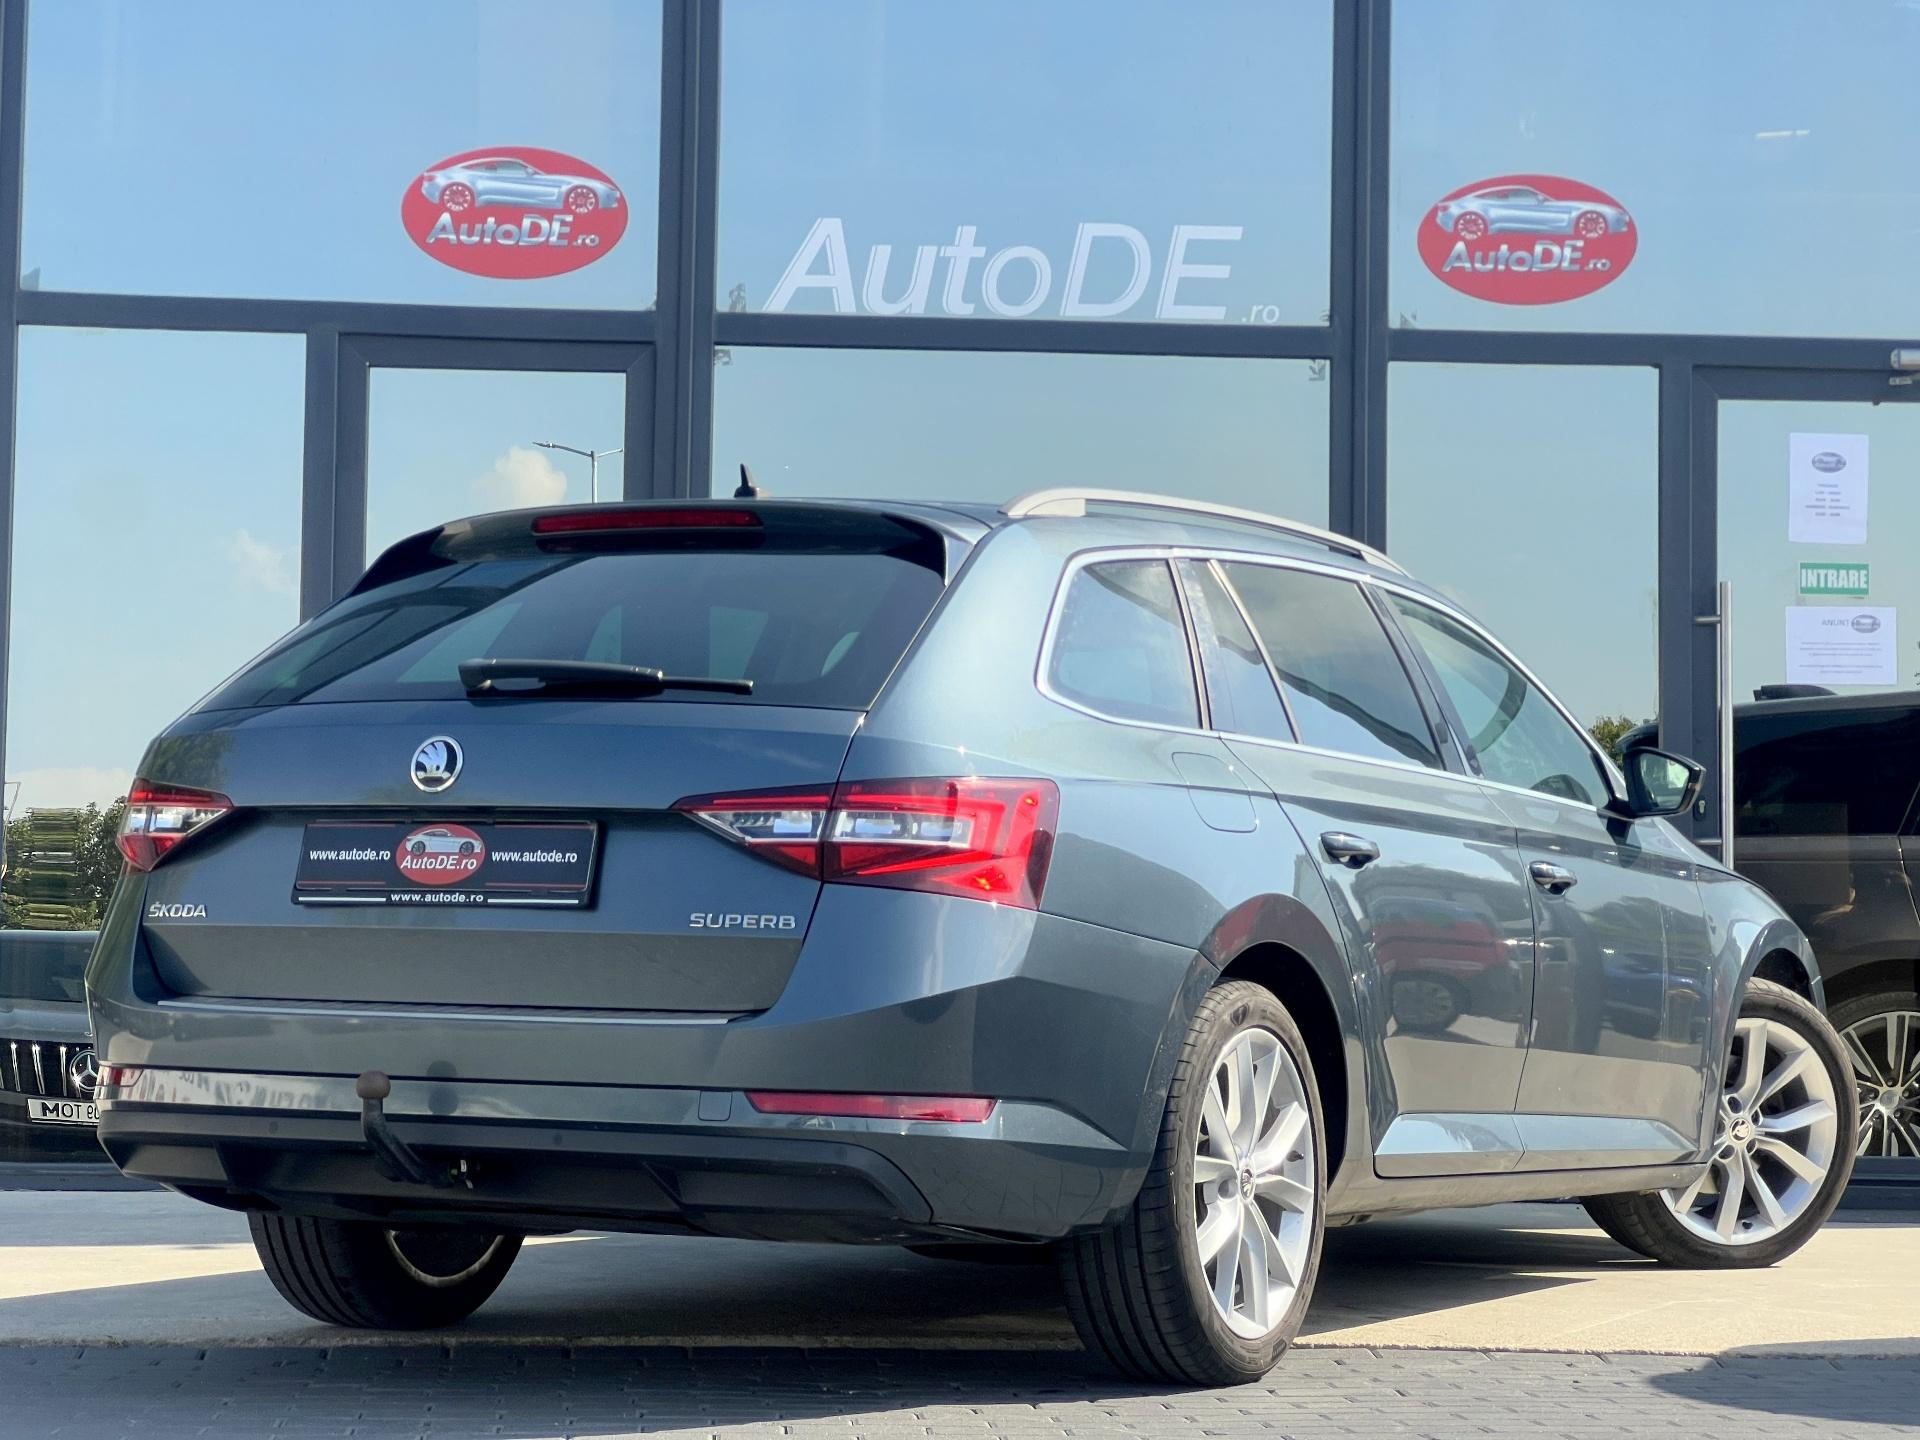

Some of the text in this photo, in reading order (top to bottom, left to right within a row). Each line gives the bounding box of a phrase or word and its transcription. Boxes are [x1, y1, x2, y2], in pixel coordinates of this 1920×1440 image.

[1800, 568, 1869, 590] INTRARE
[309, 848, 391, 862] www.autode.ro
[491, 850, 578, 864] www.autode.ro
[400, 855, 478, 871] AutoDE.ro
[390, 892, 485, 904] www.autode.ro
[688, 912, 797, 930] SUPERB
